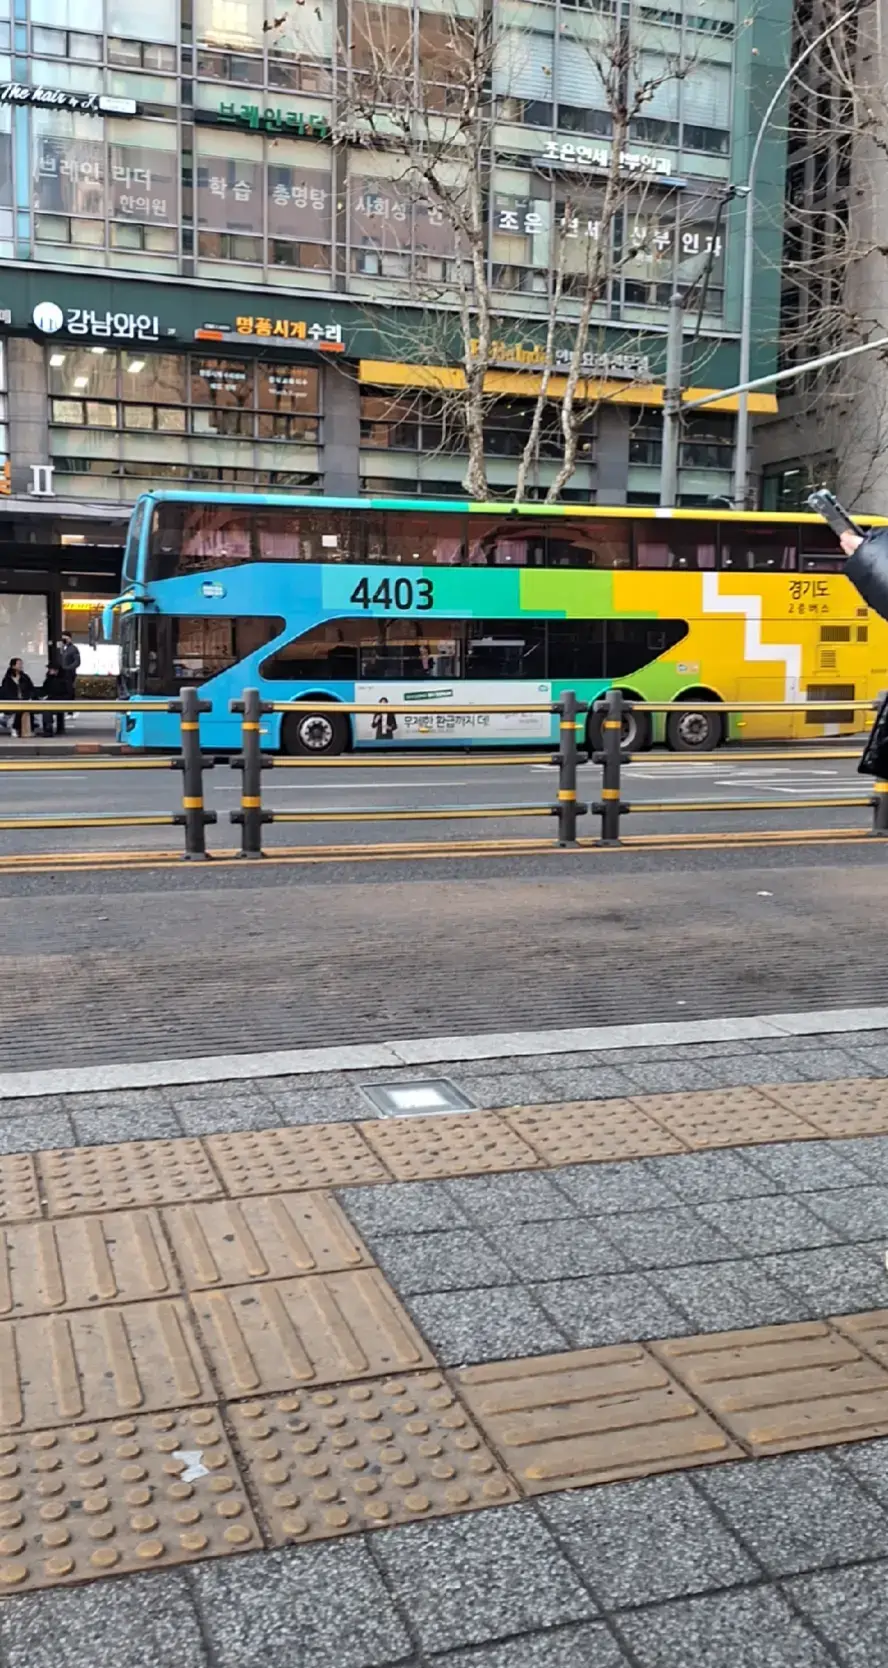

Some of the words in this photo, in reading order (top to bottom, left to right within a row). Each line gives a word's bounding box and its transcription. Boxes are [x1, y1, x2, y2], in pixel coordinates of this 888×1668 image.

[0, 83, 30, 100] The
[31, 86, 67, 104] hair
[216, 102, 327, 136] 브레인리더
[119, 194, 168, 217] 한의원
[272, 183, 327, 210] 총명탕
[67, 308, 159, 341] 강남와인
[236, 316, 307, 340] 명품시계
[308, 323, 342, 344] 수리
[350, 577, 434, 610] 4403
[789, 580, 830, 600] 경기도
